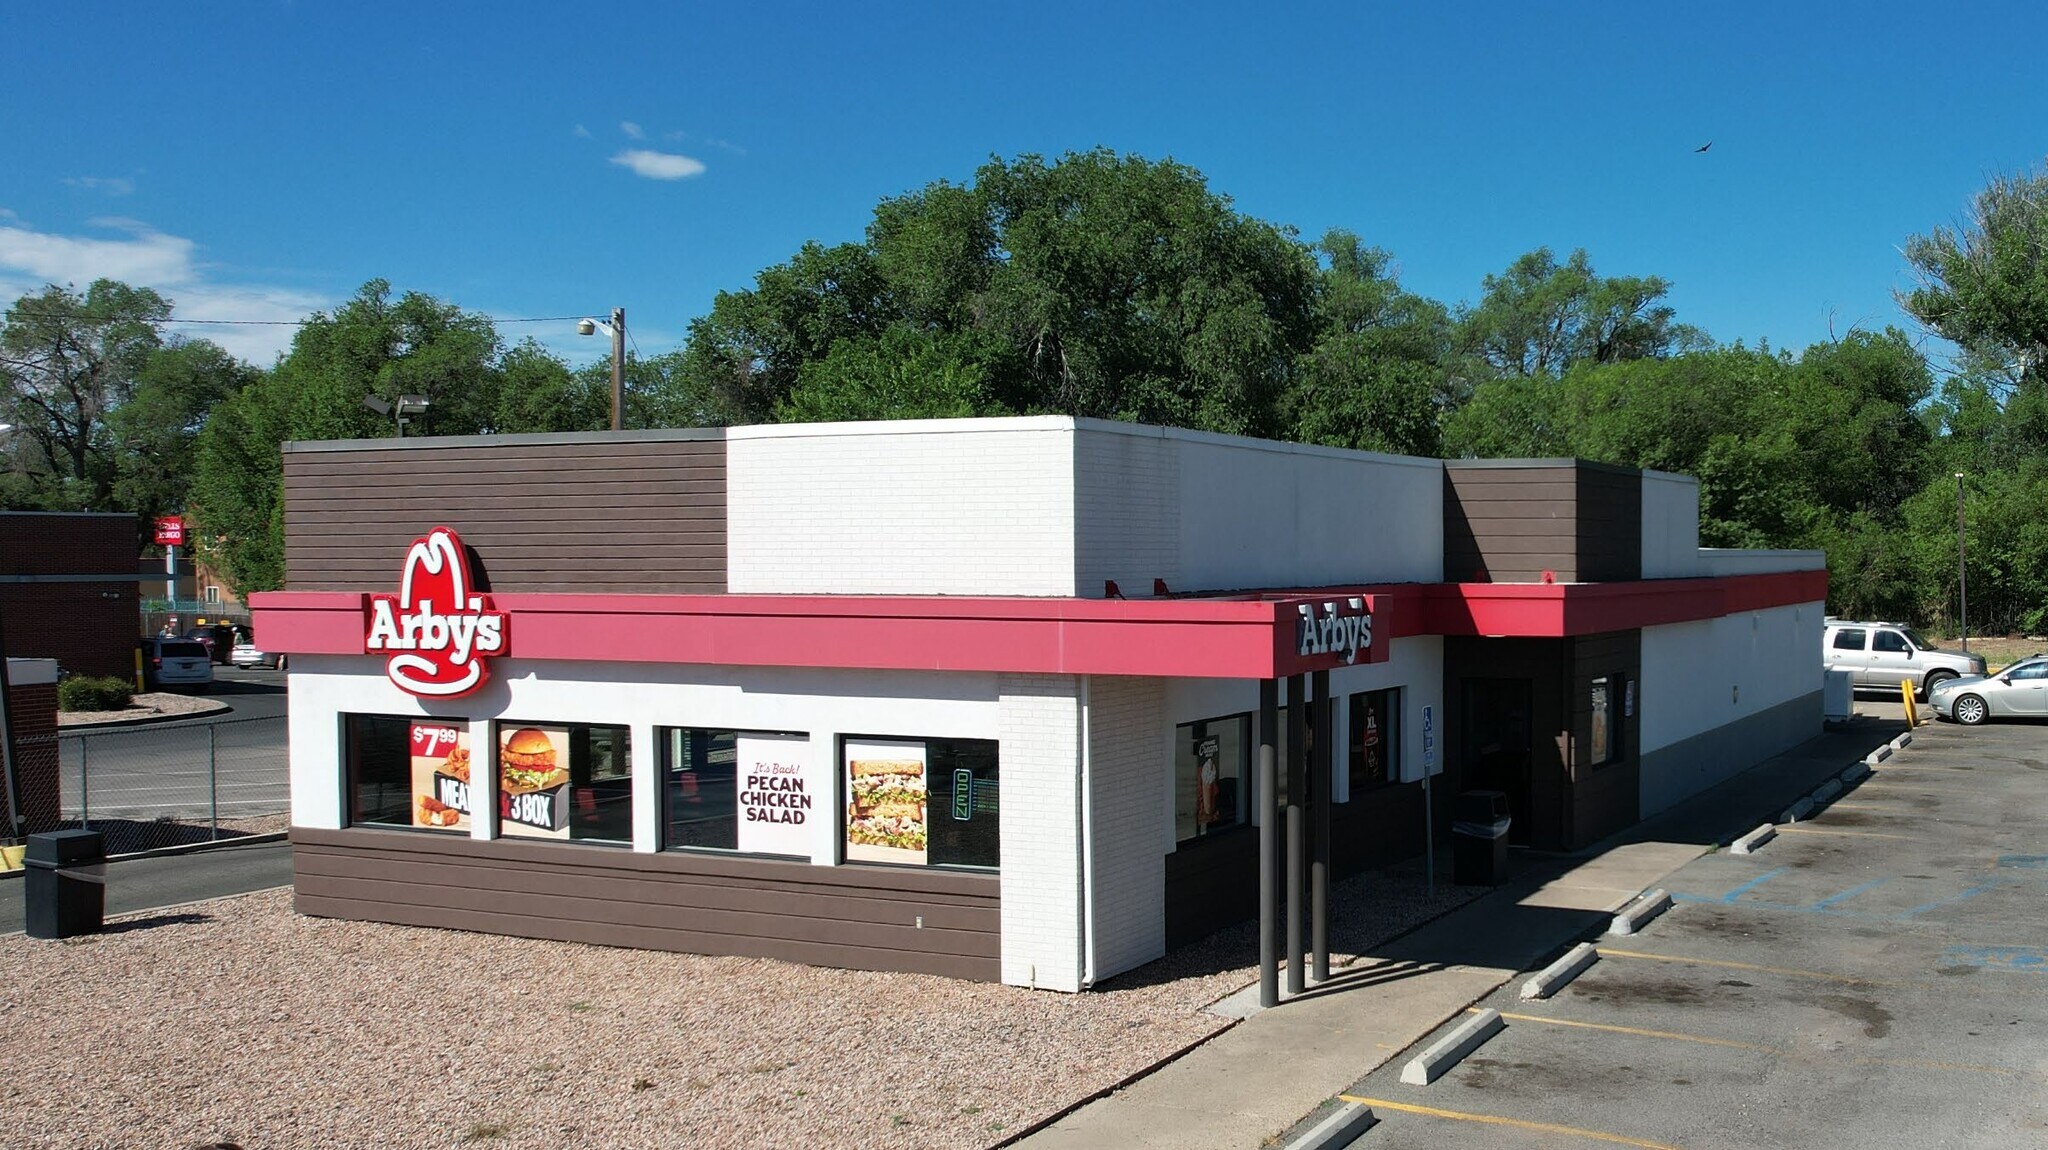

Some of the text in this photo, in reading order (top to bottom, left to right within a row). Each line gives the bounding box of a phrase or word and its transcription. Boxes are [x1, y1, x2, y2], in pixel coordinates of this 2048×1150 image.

[367, 597, 502, 665] Arby's
[1298, 598, 1372, 665] Arby's
[753, 762, 800, 774] It's Back!
[747, 775, 804, 793] PECAN
[956, 772, 969, 818] OPEN
[511, 794, 521, 819] 3
[522, 793, 551, 827] BOX
[740, 791, 811, 809] CHICKEN
[746, 807, 806, 825] SALAD
